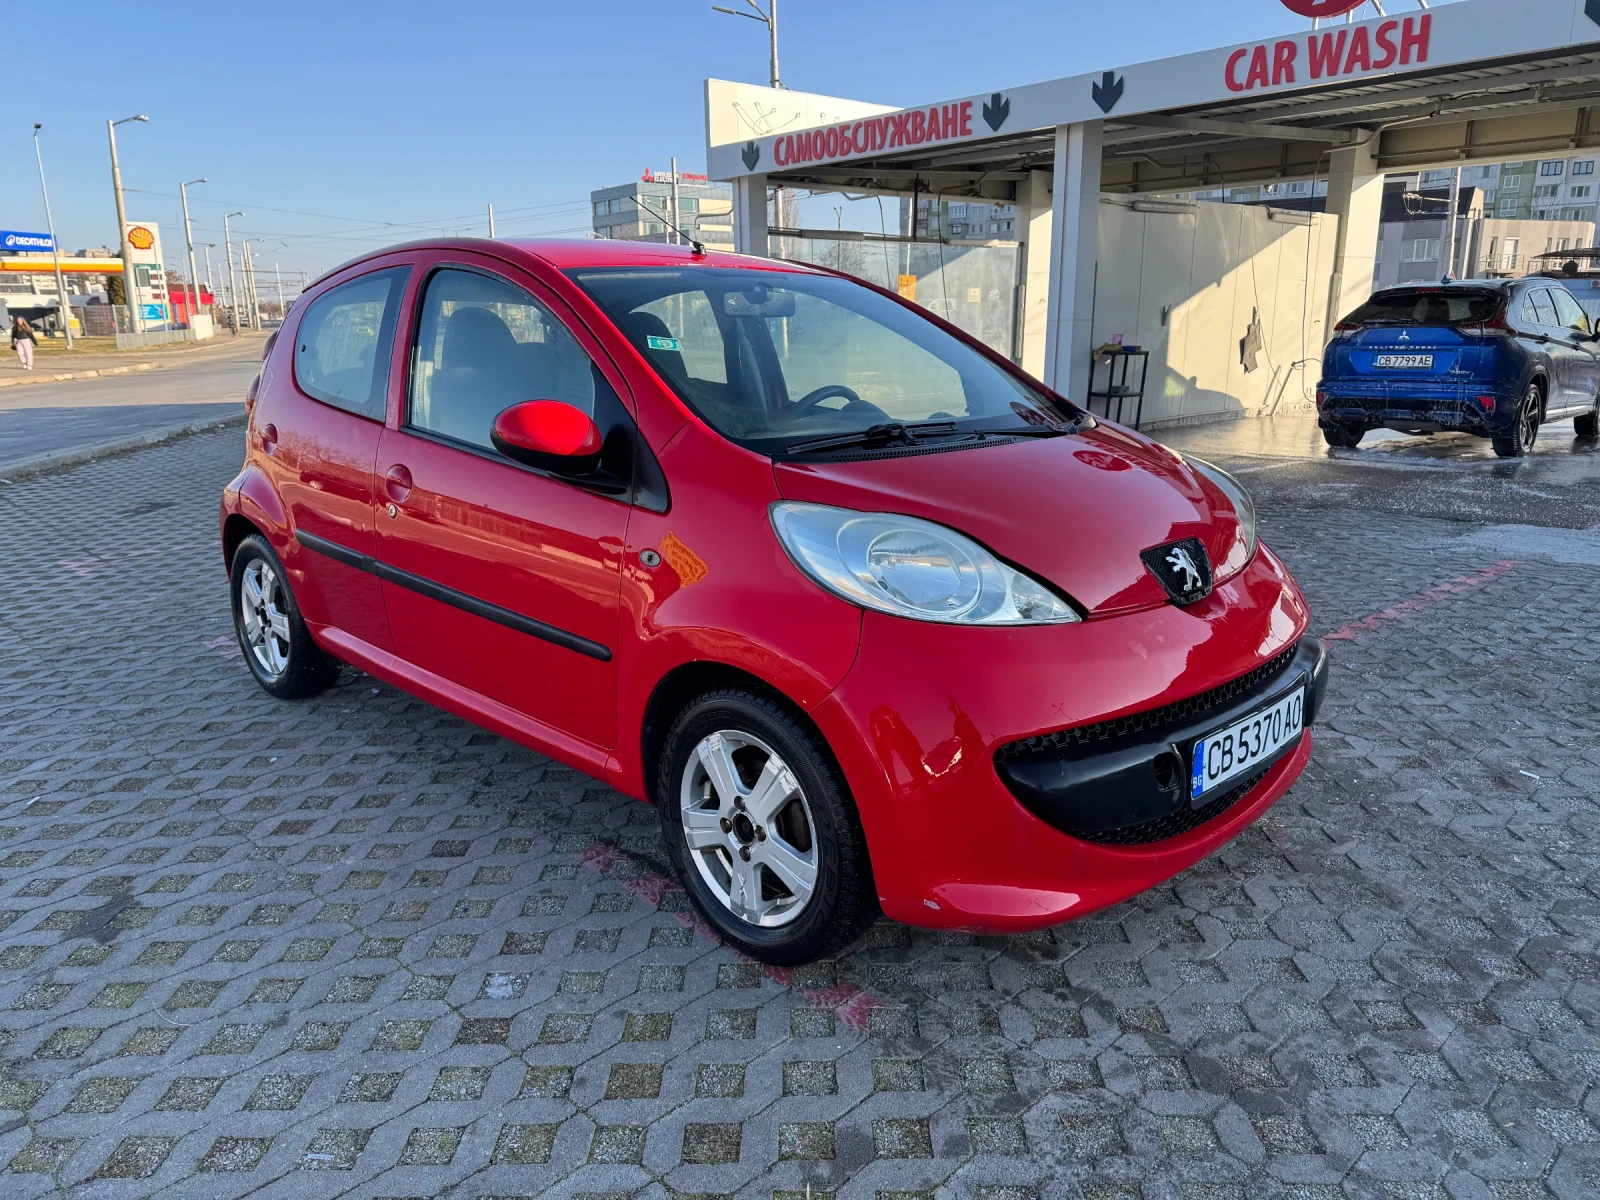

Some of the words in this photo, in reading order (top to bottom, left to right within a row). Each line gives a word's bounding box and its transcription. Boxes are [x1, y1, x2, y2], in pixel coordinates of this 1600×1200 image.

[1224, 40, 1297, 92] CAR
[1307, 14, 1432, 79] WASH
[773, 100, 973, 166] САМООБСЛУЖВАНЕ
[1378, 356, 1391, 366] CB
[1393, 356, 1417, 366] 7799
[1418, 356, 1432, 366] AE
[1207, 734, 1234, 780] CB
[1237, 708, 1282, 764] 5370
[1283, 694, 1301, 739] AO
[1192, 774, 1203, 789] BG
